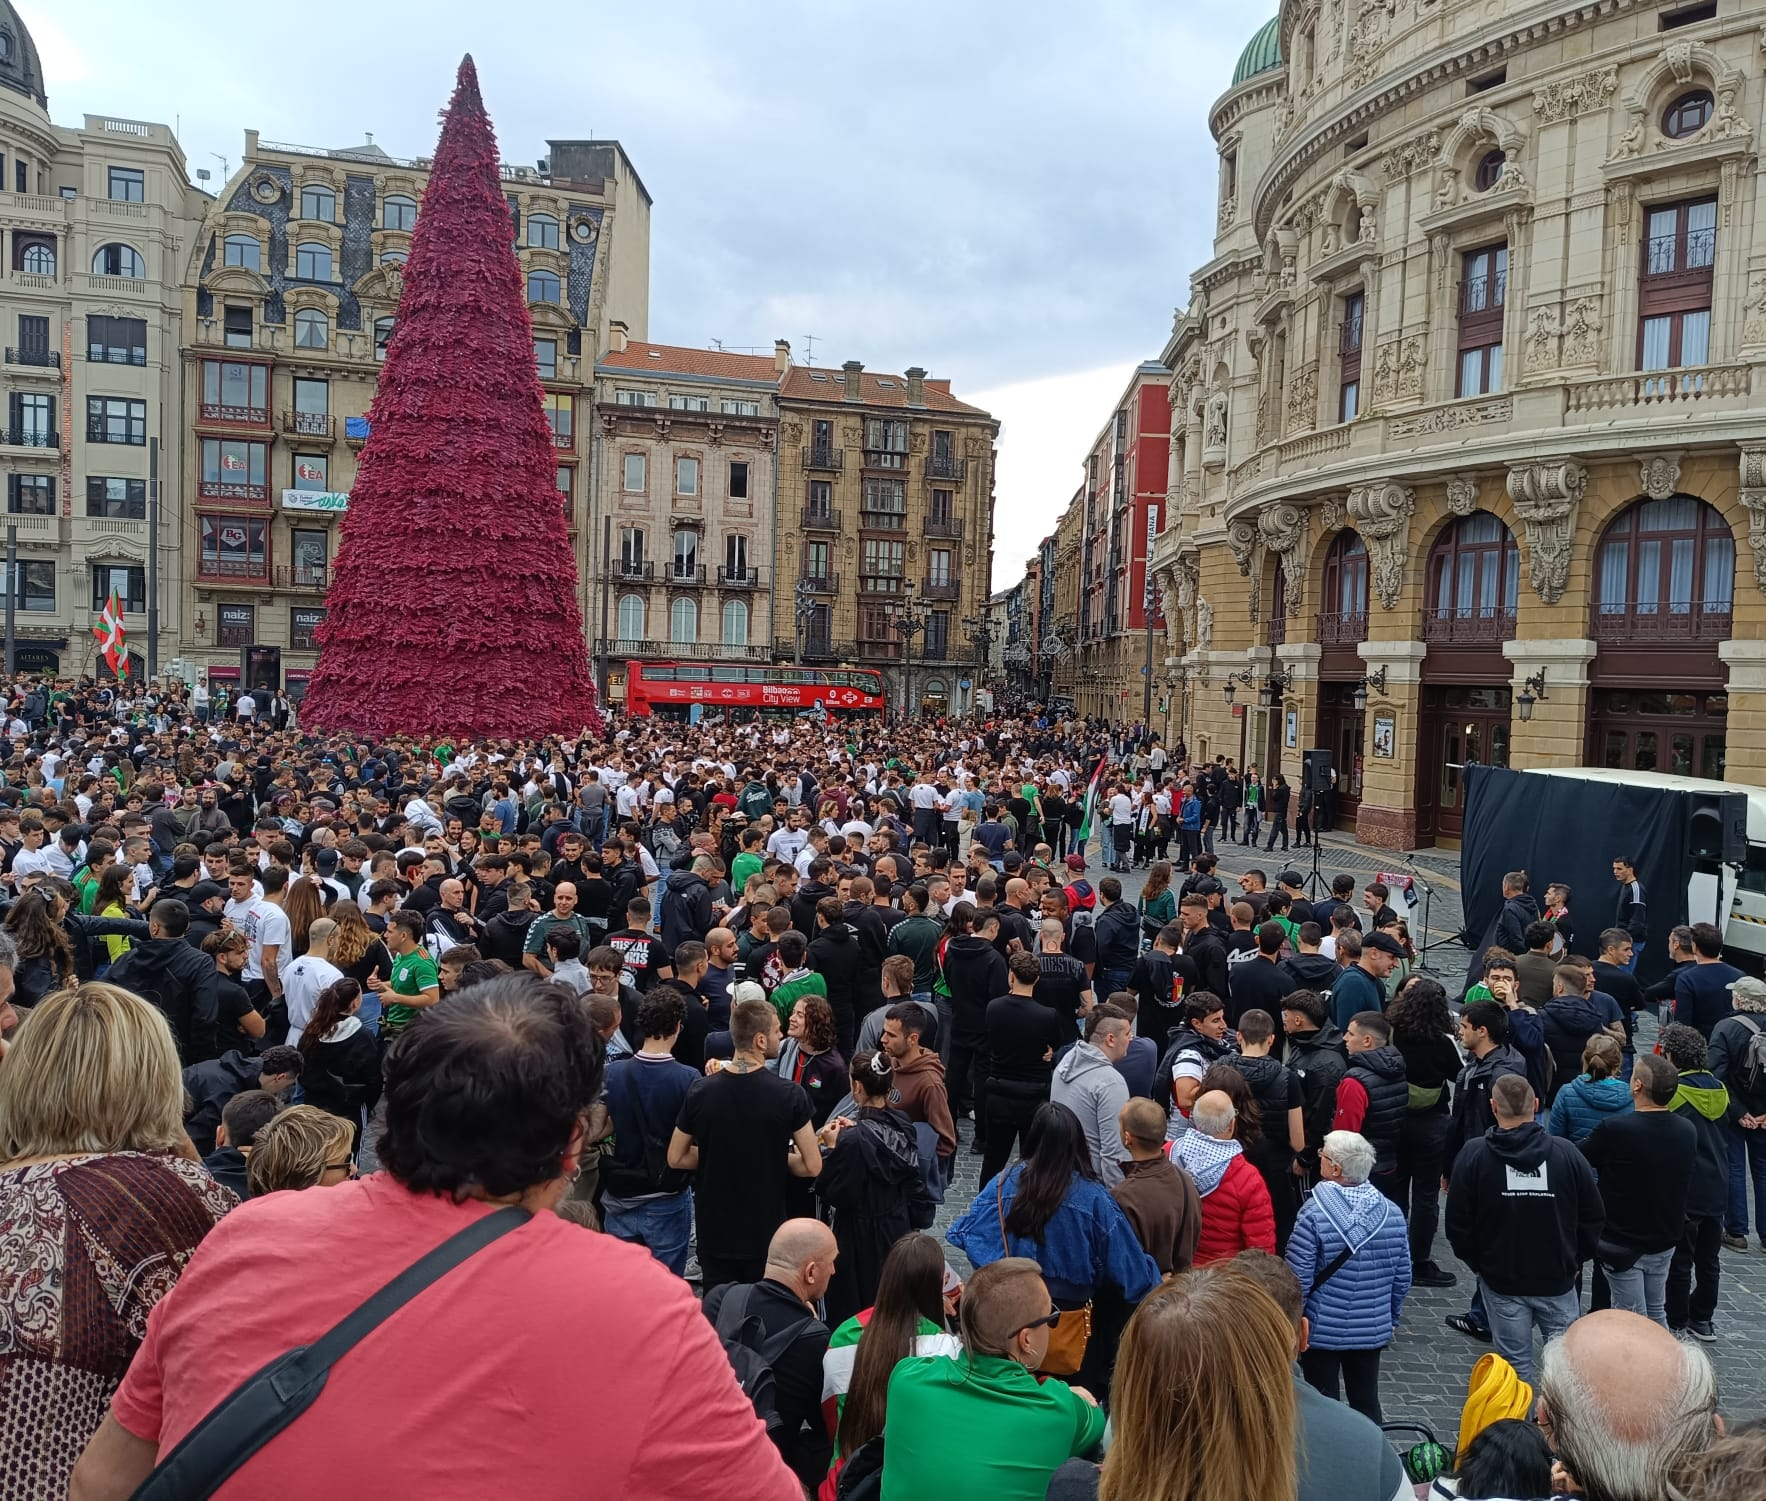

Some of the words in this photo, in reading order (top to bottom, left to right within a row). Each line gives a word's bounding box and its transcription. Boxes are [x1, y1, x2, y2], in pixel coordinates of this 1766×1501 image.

[225, 529, 242, 539] BG
[303, 543, 318, 553] BG
[223, 609, 250, 620] naiz:
[296, 612, 322, 623] naiz:
[763, 685, 786, 694] Bilbao
[763, 694, 779, 705] City
[780, 694, 801, 703] View
